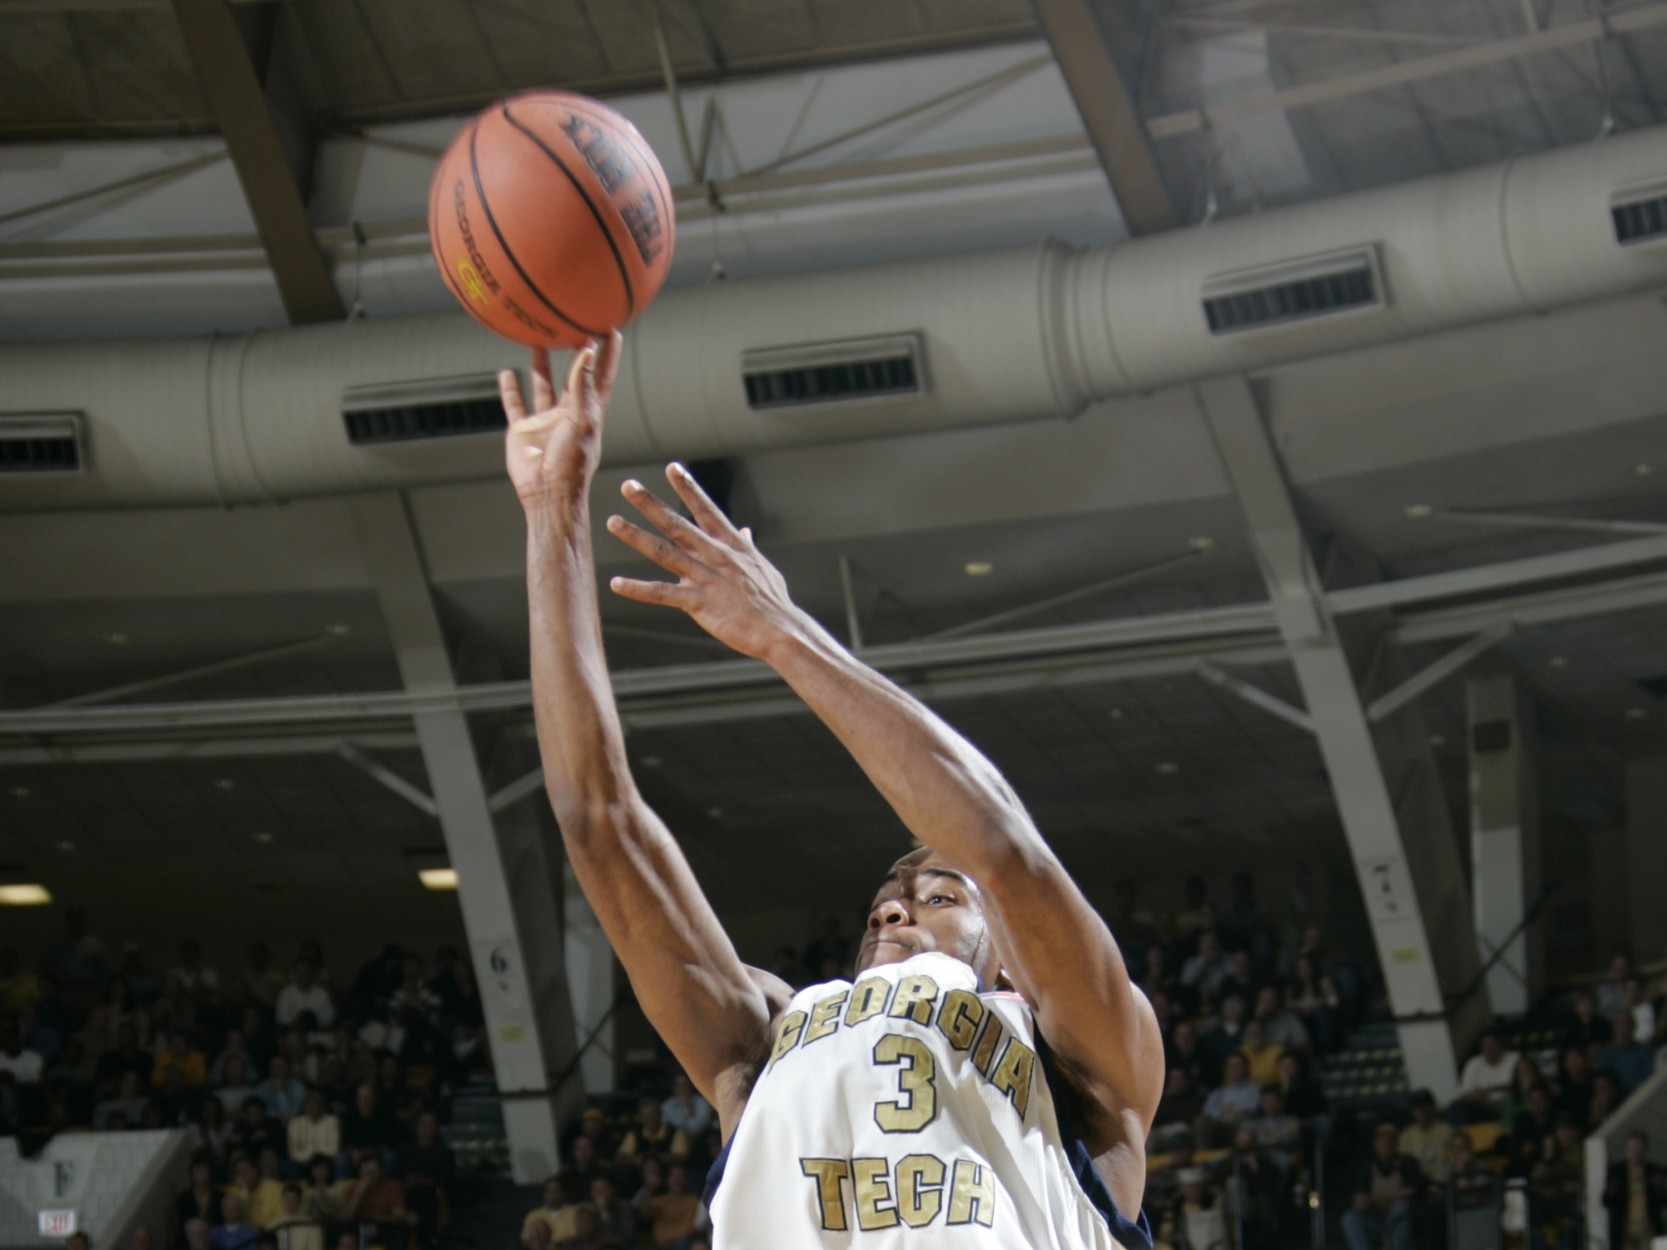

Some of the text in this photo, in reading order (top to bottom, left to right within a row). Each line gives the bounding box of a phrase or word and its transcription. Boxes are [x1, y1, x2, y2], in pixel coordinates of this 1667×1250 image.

[453, 180, 501, 296] GEORGIA
[768, 974, 1035, 1123] GEORGIA
[872, 1033, 937, 1134] 3
[44, 1212, 70, 1236] EXIT
[799, 1153, 996, 1232] TECH
